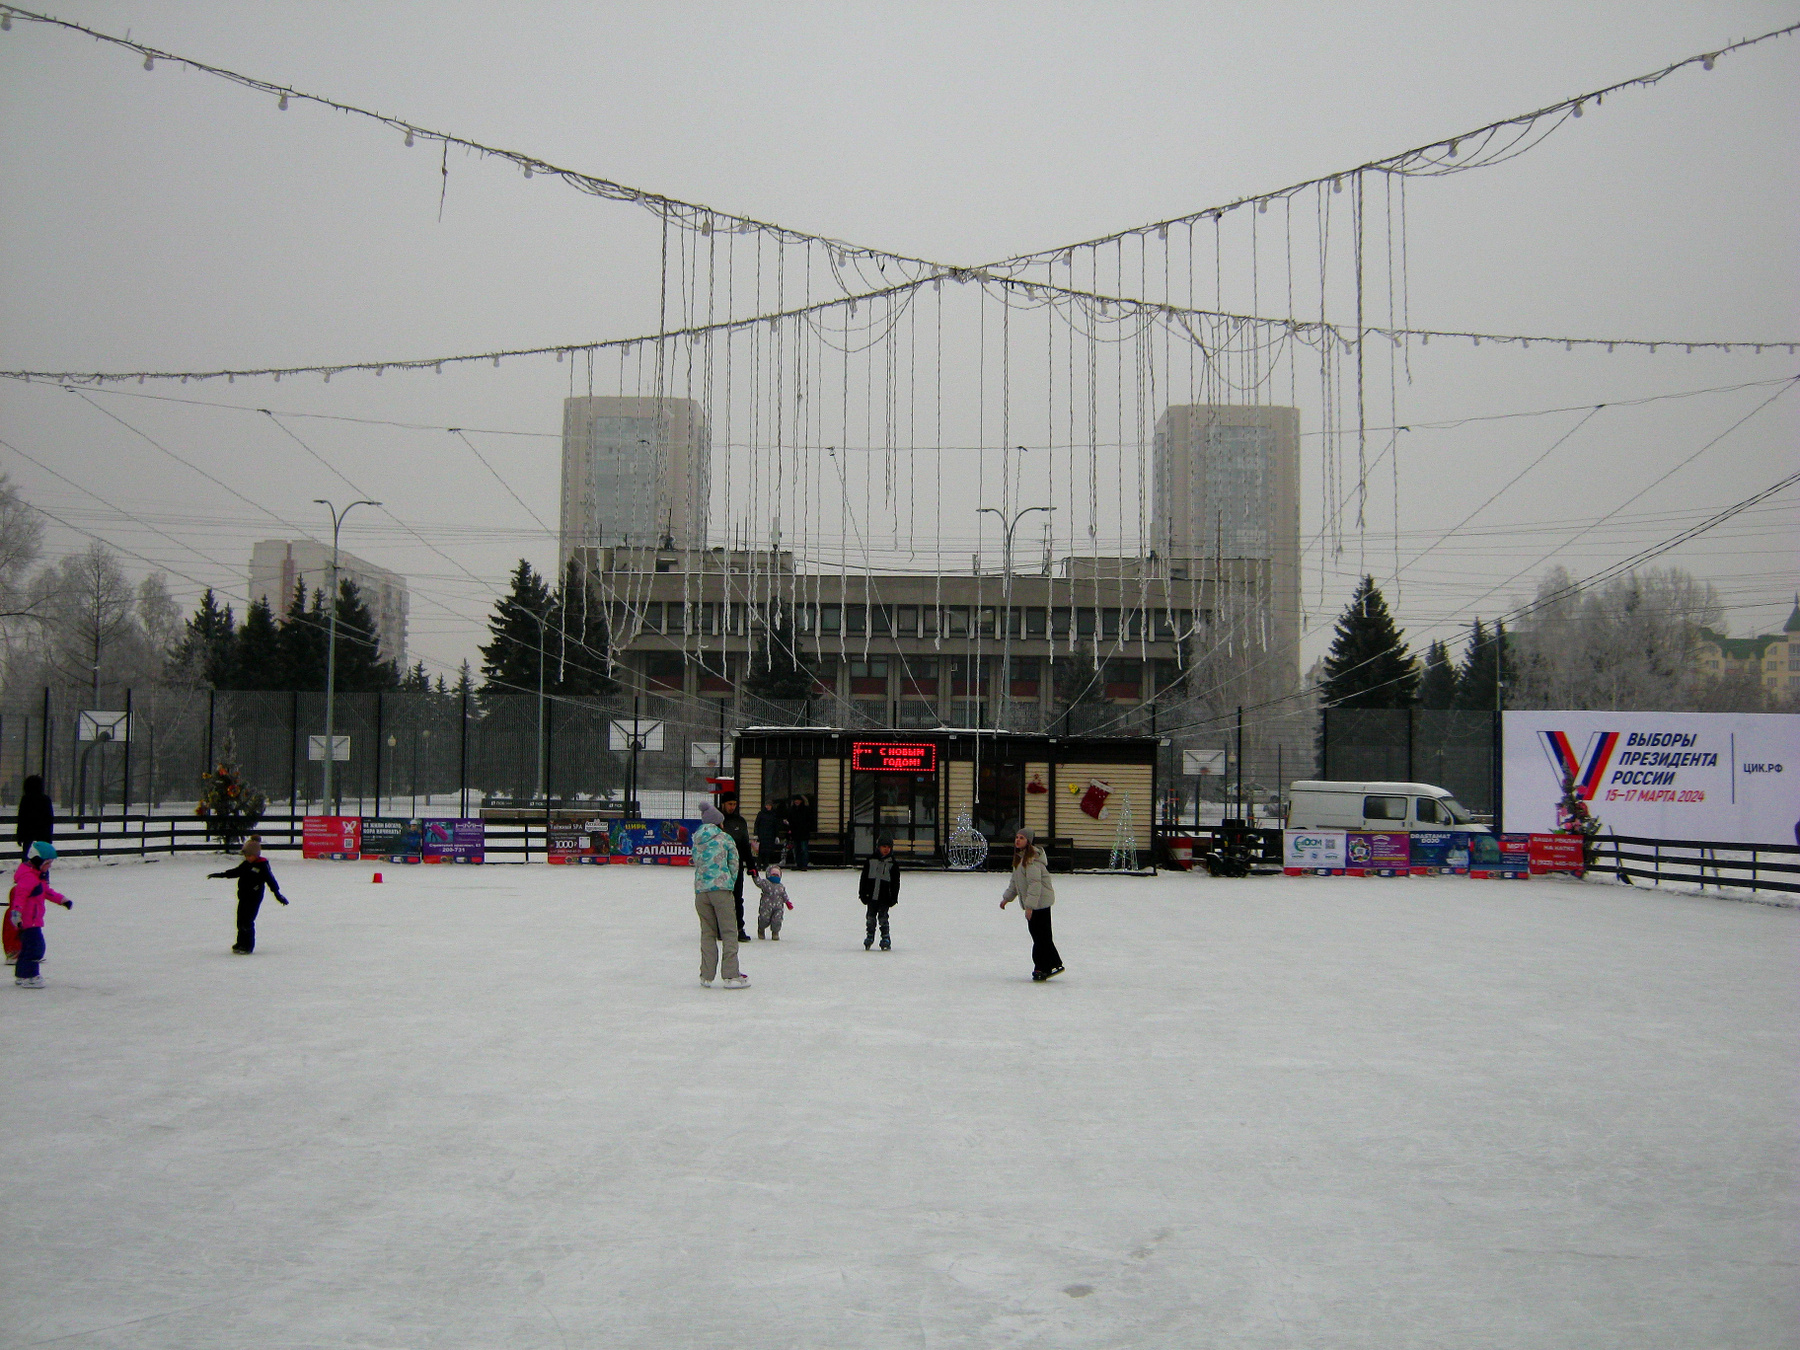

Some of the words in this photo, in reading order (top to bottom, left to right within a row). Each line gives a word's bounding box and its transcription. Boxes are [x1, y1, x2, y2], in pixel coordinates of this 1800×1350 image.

[1627, 733, 1697, 747] ВЫБОРЫ
[879, 747, 887, 756] С
[888, 747, 925, 757] НОВЫМ
[883, 757, 922, 767] ГОДОМ!
[1618, 752, 1718, 768] ПРЕЗИДЕНТА
[1743, 763, 1783, 774] ЦИК.РФ
[1611, 770, 1676, 785] РОССИИ
[1637, 790, 1676, 802] МАРТА
[1677, 790, 1705, 802] 2024
[555, 840, 573, 848] 1000
